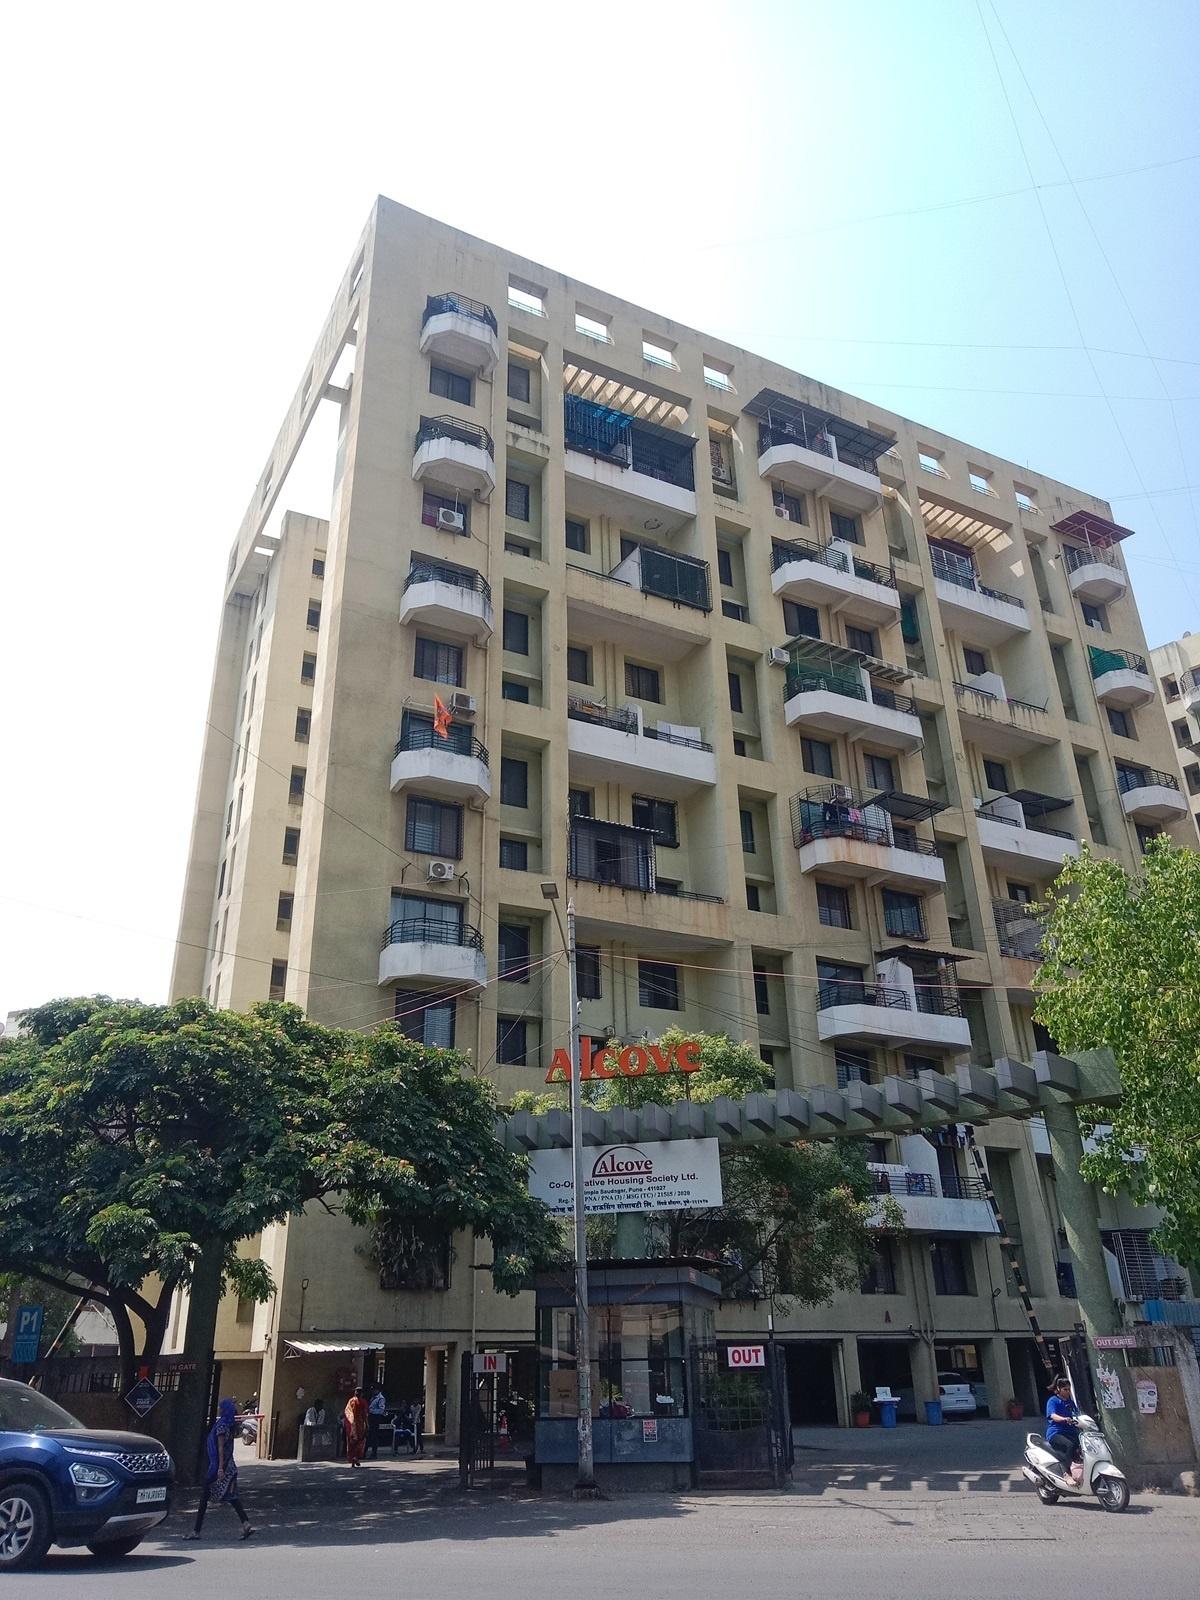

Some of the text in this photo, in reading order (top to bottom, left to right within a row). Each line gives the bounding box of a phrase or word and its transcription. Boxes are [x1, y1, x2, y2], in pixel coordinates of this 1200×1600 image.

[545, 1036, 702, 1084] Alcove
[597, 1154, 653, 1174] Alcove
[608, 1177, 644, 1185] Housing
[646, 1174, 679, 1183] Society
[681, 1173, 698, 1181] Ltd.
[20, 1311, 39, 1333] P1
[484, 1356, 497, 1370] IN
[732, 1349, 761, 1364] OUT
